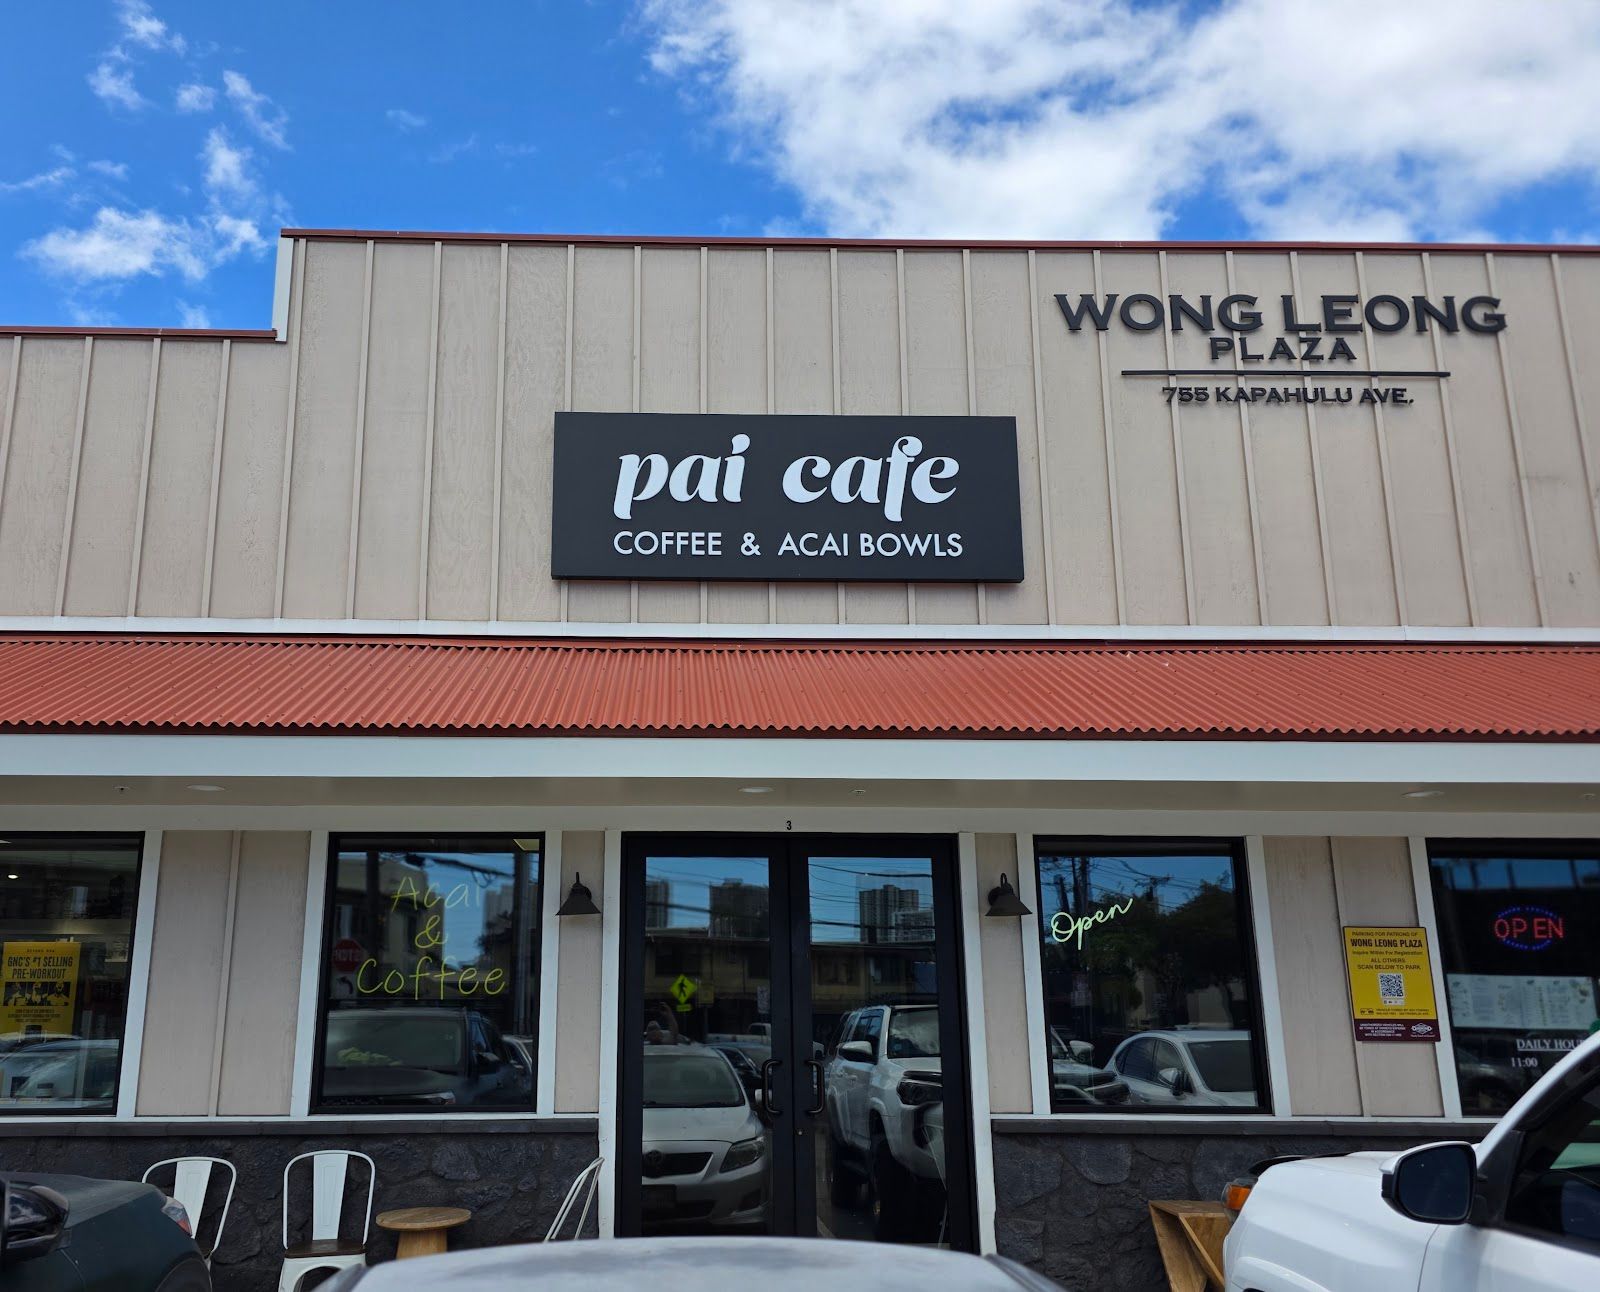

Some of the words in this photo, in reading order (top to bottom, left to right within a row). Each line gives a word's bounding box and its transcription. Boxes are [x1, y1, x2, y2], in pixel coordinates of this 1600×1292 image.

[1054, 294, 1264, 332] WONG
[1280, 294, 1507, 334] LEONG
[1209, 337, 1357, 361] PLAZA
[1162, 387, 1210, 403] 755
[1215, 387, 1353, 404] KAPAHULU
[1359, 387, 1414, 405] AVE.
[613, 433, 751, 520] pai
[782, 435, 960, 522] cafe
[613, 530, 722, 556] COFFEE
[740, 532, 761, 556] &
[778, 532, 849, 557] ACAI
[860, 532, 963, 557] BOWLS
[786, 820, 792, 831] 3
[391, 876, 481, 912] Acai
[415, 915, 448, 949] &
[1051, 898, 1133, 951] Open
[1494, 917, 1564, 939] OPEN
[1351, 938, 1373, 947] WONG
[1374, 939, 1398, 948] LEONG
[1399, 939, 1423, 948] PLAZA
[8, 956, 31, 968] GNC'S
[43, 956, 73, 968] SELLING
[12, 968, 66, 979] PRE-WORKOUT
[357, 956, 505, 1000] Coffee
[1516, 1039, 1551, 1049] DAILY
[1510, 1057, 1538, 1068] 11:00
